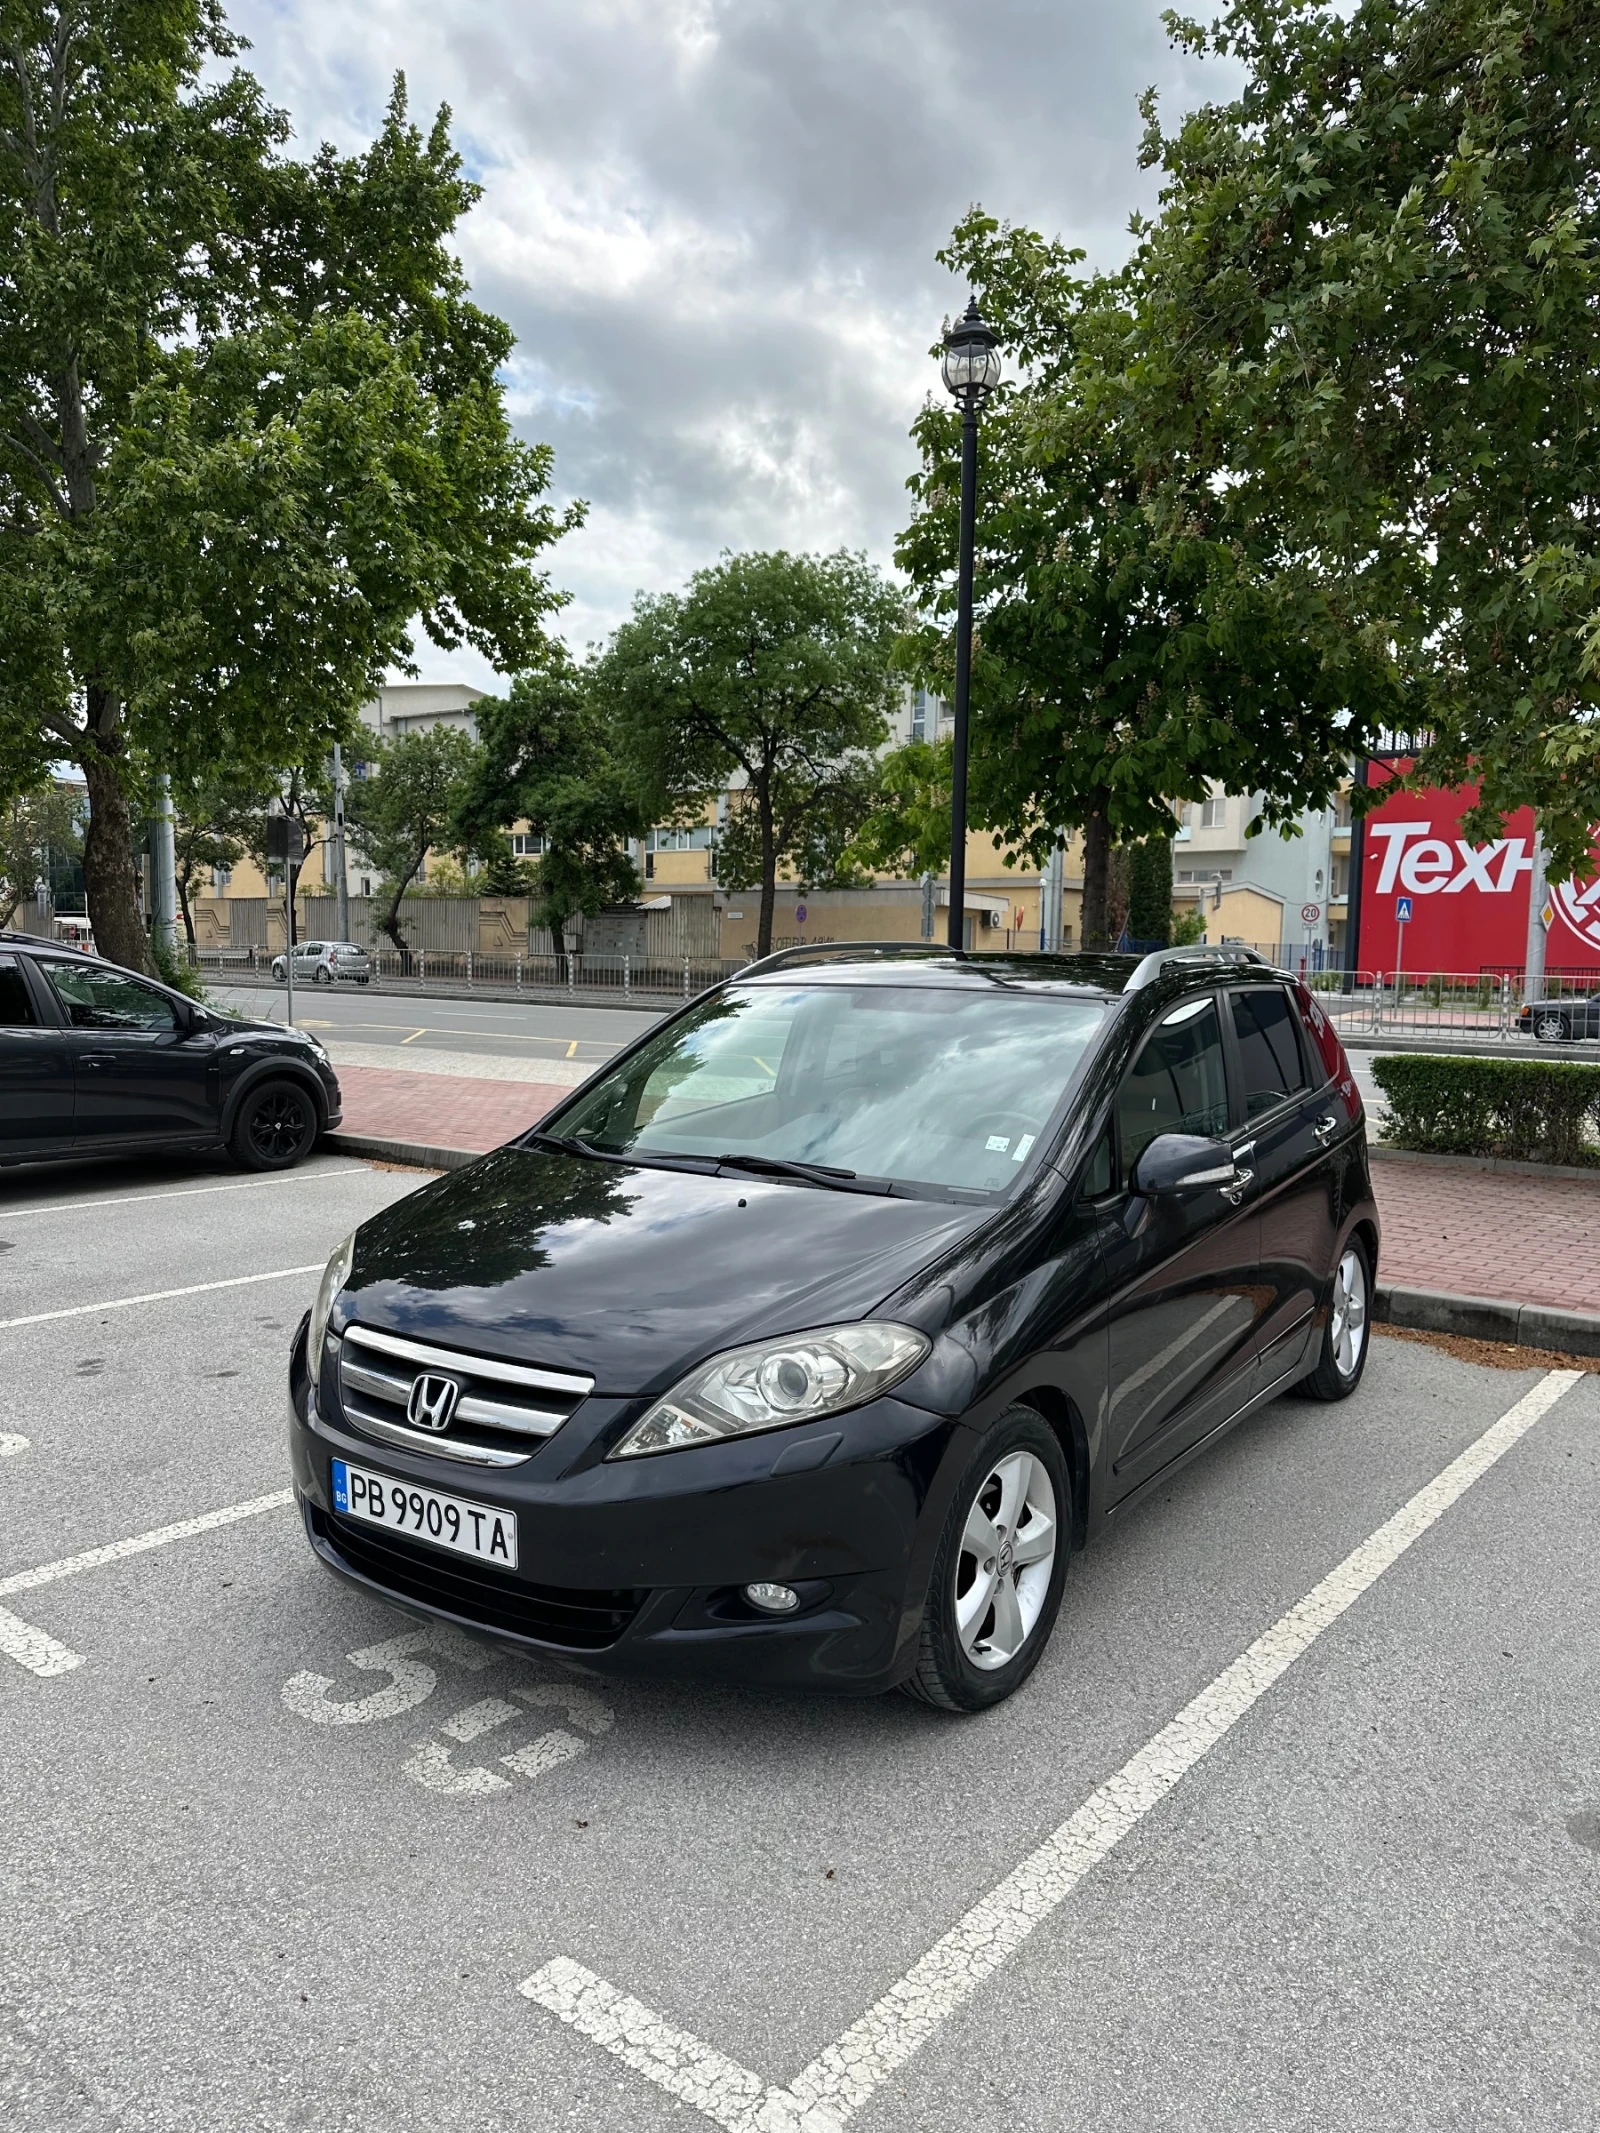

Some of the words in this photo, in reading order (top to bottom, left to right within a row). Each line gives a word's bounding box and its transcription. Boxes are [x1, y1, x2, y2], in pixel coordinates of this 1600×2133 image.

[1305, 908, 1317, 918] 20
[336, 1490, 347, 1504] BG
[350, 1472, 386, 1518] PB
[391, 1487, 461, 1543] 9909
[467, 1509, 509, 1559] TA
